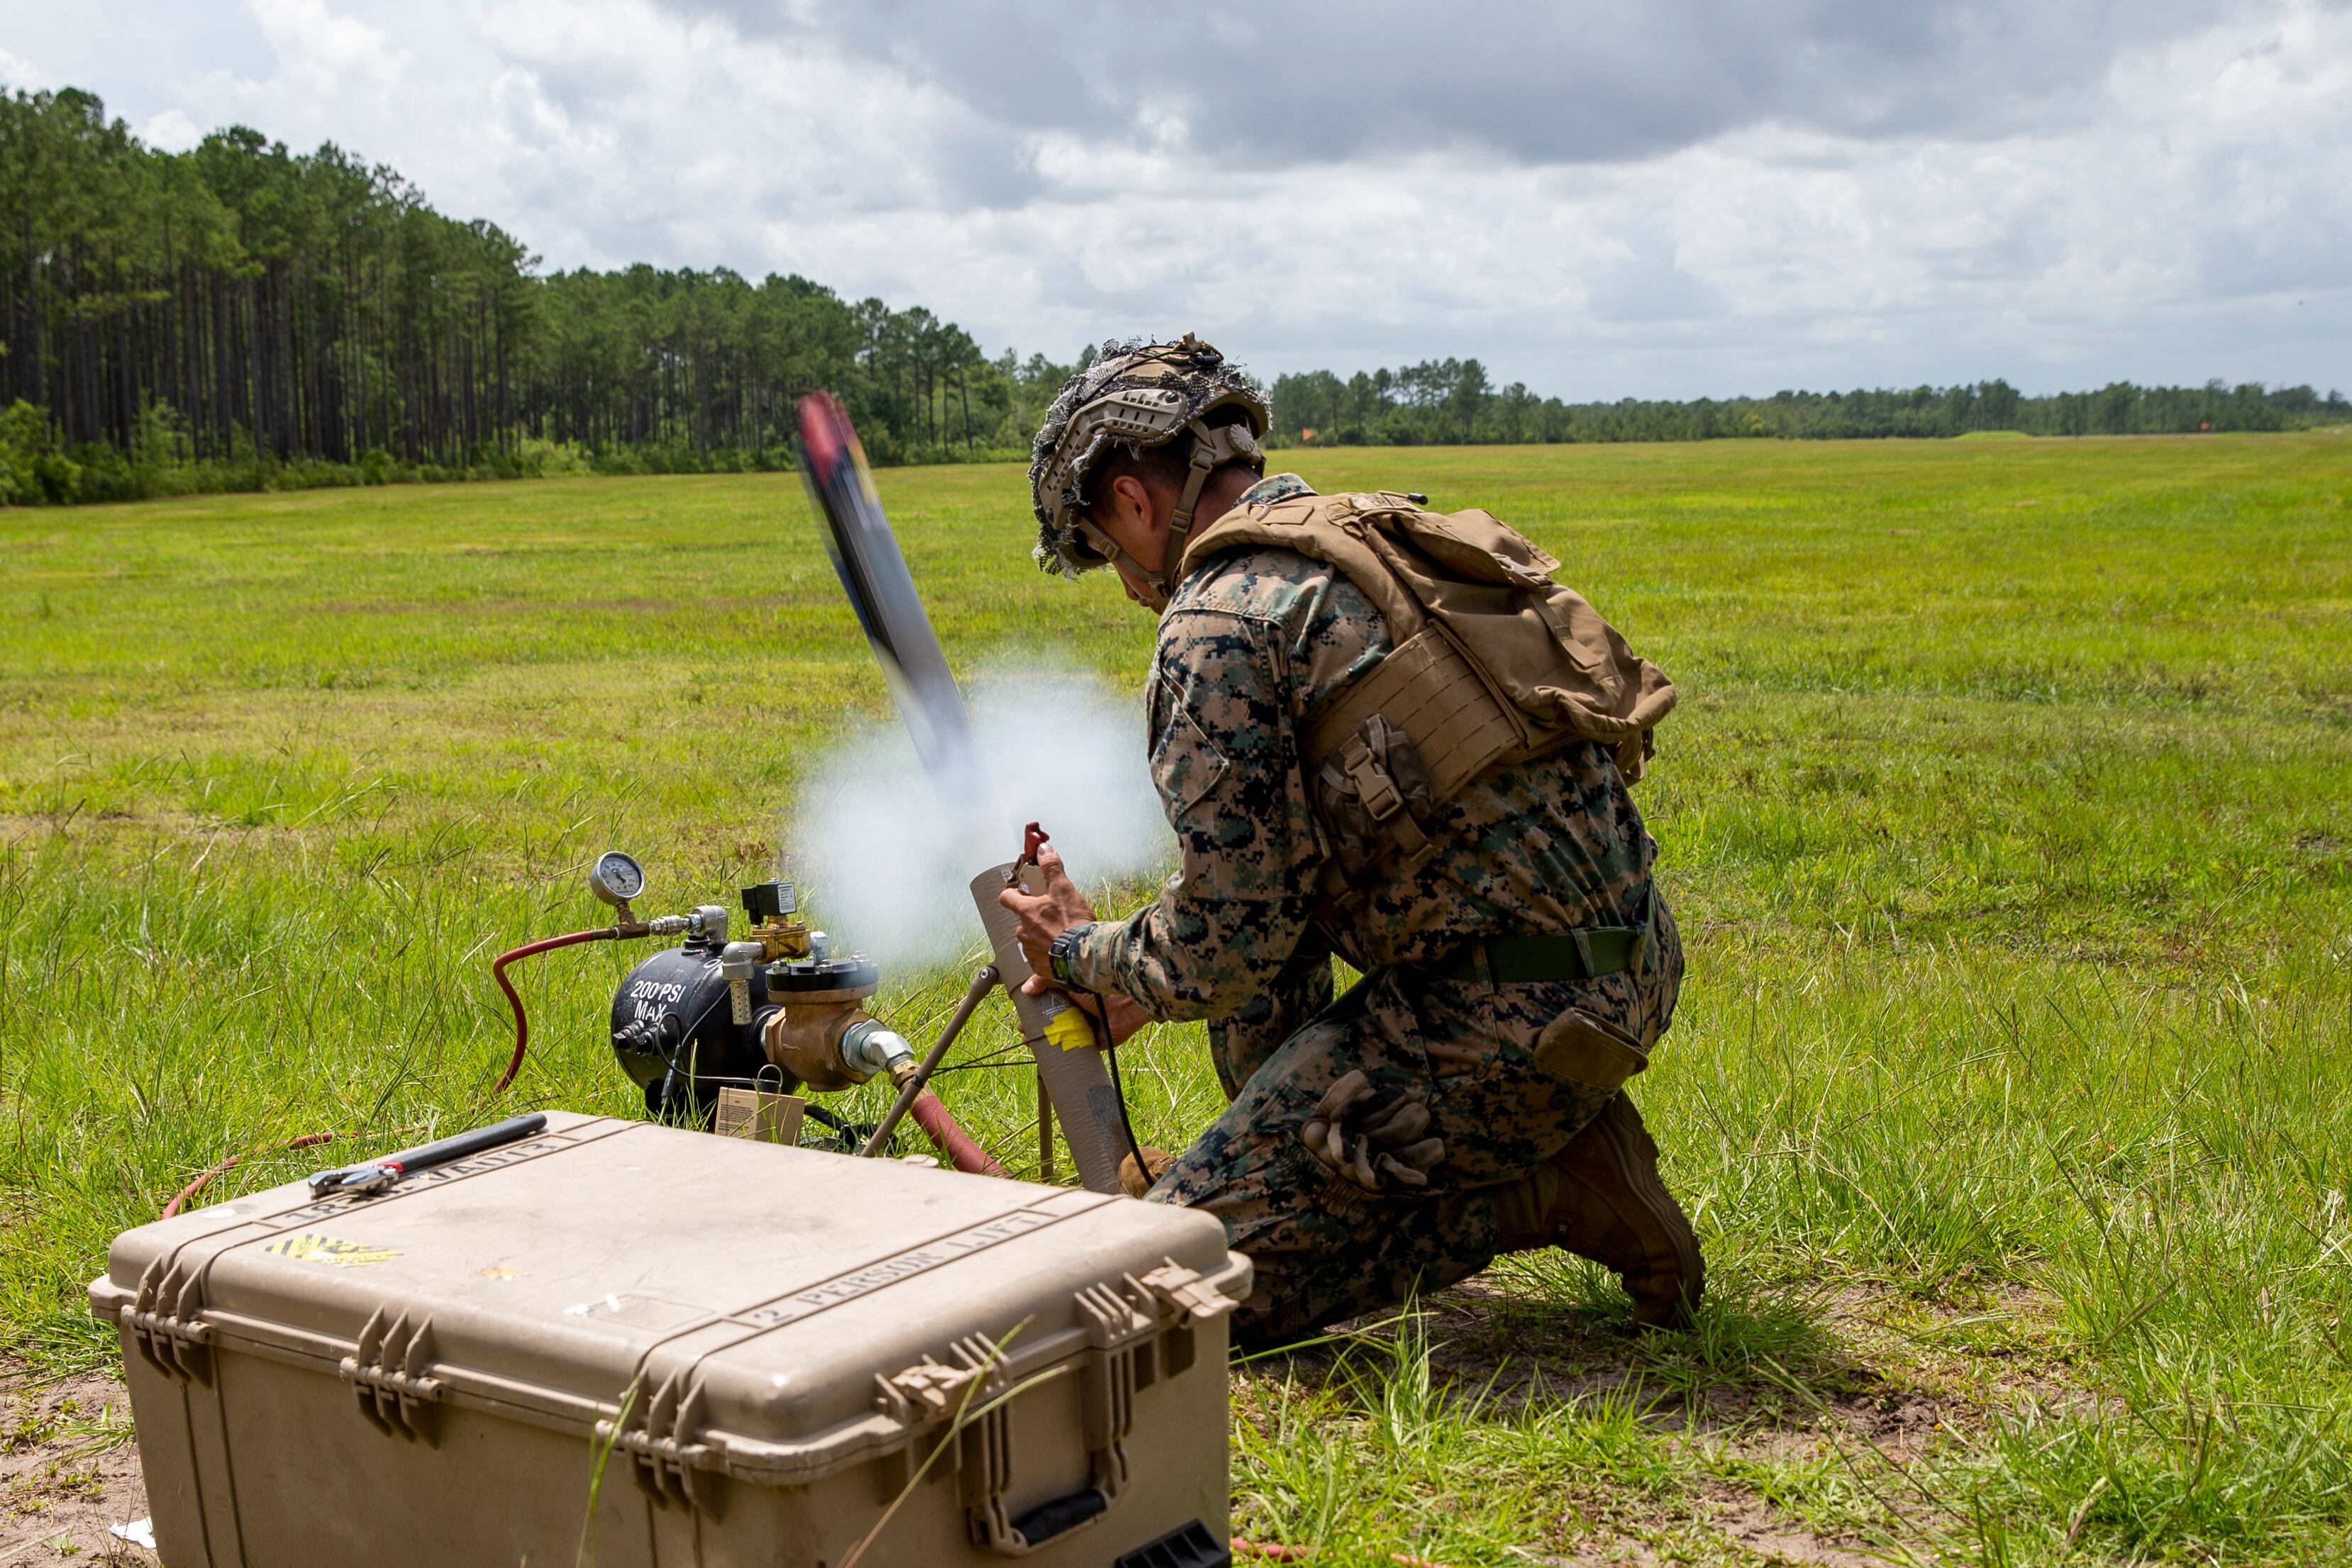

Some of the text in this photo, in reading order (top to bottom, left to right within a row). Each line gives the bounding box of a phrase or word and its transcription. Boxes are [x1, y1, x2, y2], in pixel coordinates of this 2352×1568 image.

[630, 980, 687, 1003] 200 PSI
[634, 999, 667, 1022] MAX
[753, 1216, 1038, 1323] 2 PERSON LIFT
